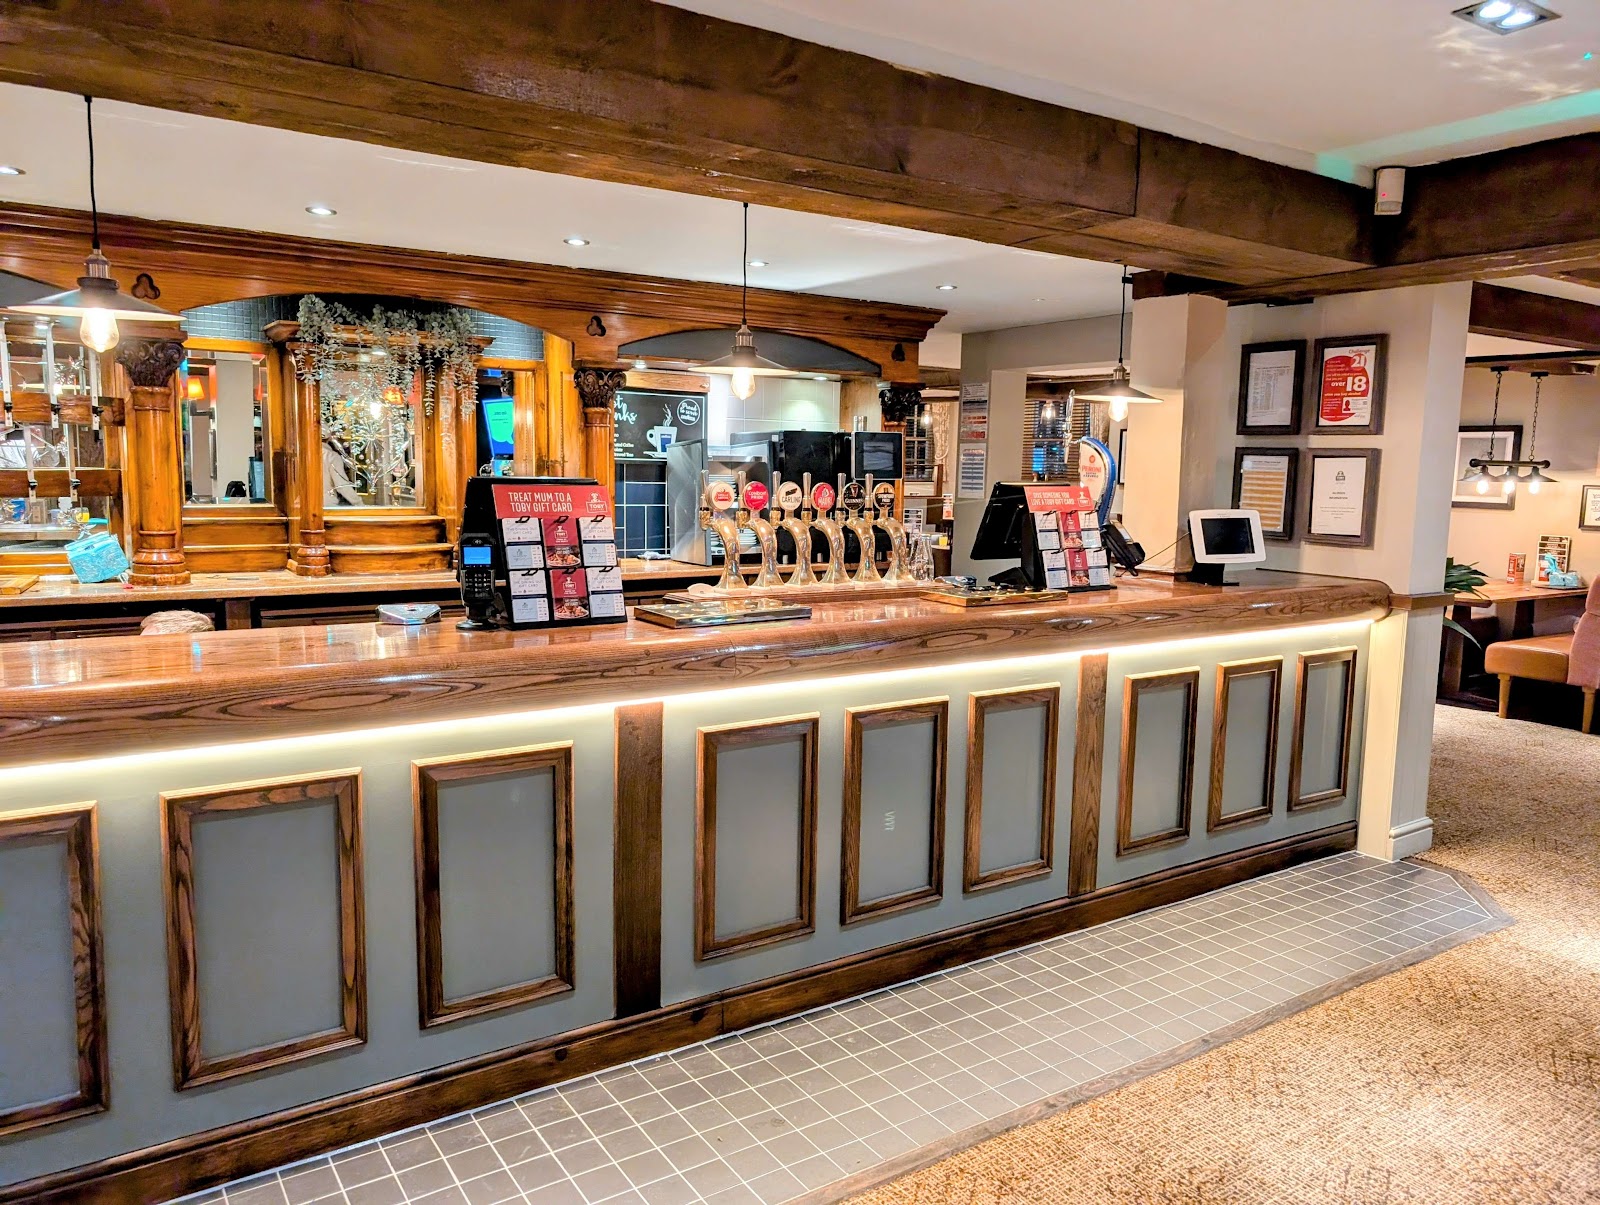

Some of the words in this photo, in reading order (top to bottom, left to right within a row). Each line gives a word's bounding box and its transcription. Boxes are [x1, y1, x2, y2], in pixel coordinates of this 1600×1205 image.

[1351, 356, 1366, 368] 21
[1346, 376, 1367, 392] 18
[508, 492, 532, 502] TREAT
[534, 492, 553, 502] MUM
[554, 492, 565, 502] TO
[566, 492, 572, 502] A
[510, 502, 531, 512] TOBY
[533, 502, 551, 512] GIFT
[551, 503, 573, 512] CARD
